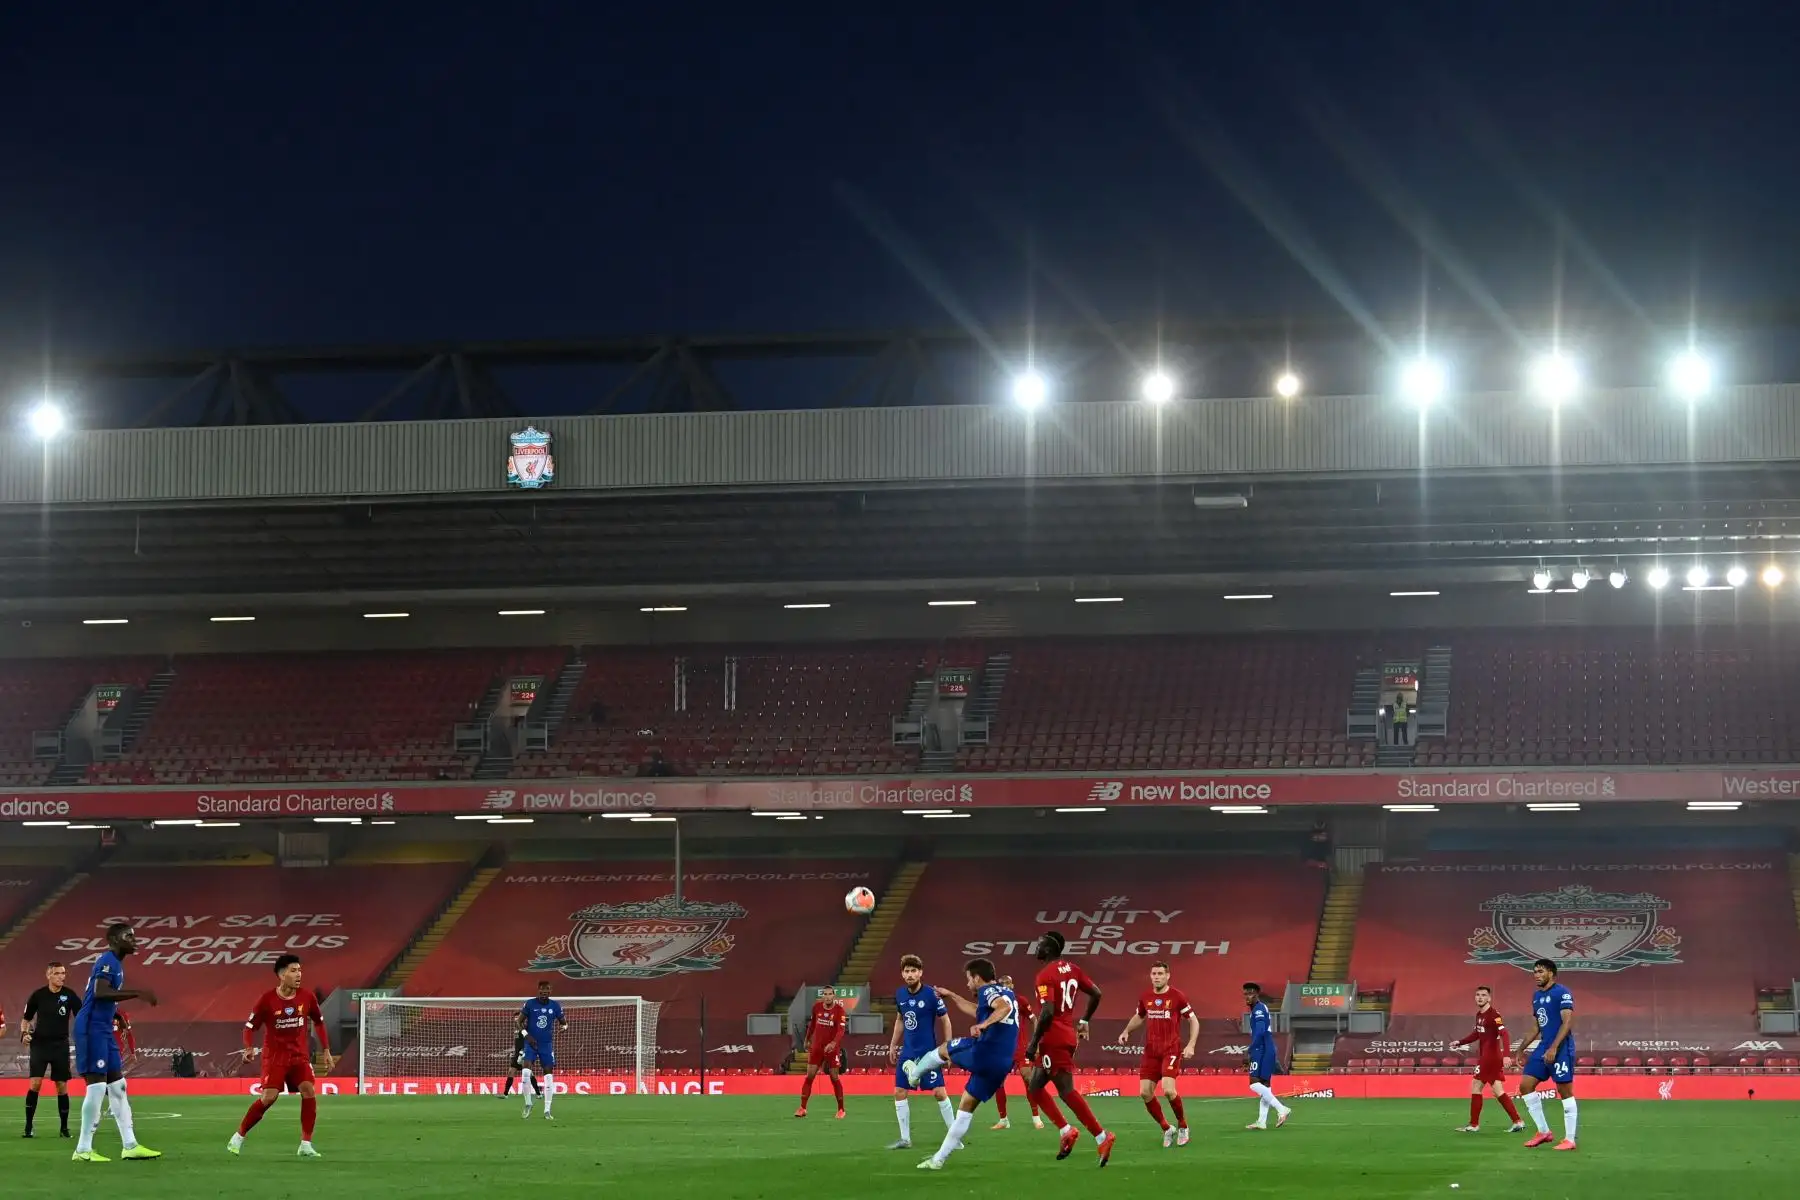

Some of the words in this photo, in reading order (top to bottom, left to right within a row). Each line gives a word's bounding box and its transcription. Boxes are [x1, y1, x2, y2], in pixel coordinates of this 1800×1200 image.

[1131, 785, 1175, 800] new
[1179, 780, 1271, 799] balance
[1398, 779, 1490, 798] Standard
[1495, 777, 1598, 797] Chartered
[1724, 776, 1800, 795] Wester
[523, 794, 565, 809] new
[569, 789, 657, 808] balance
[768, 786, 854, 805] Standard
[860, 784, 956, 804] Chartered
[0, 798, 70, 816] alance
[197, 795, 281, 813] Standard
[286, 793, 378, 811] Chartered
[97, 915, 213, 929] STAY
[219, 913, 343, 927] SAFE.
[1035, 910, 1184, 924] UNITY
[1507, 917, 1644, 925] LIVERPOOL
[585, 924, 711, 934] LIVERPOOL
[1079, 925, 1125, 939] IS
[285, 934, 349, 949] US
[143, 950, 288, 966] HOME
[817, 989, 840, 997] ET
[1060, 978, 1079, 1012] 10
[1302, 986, 1322, 995] EXIT
[366, 1002, 377, 1010] 24
[1313, 997, 1330, 1006] 126
[706, 1044, 754, 1053] AXA
[1732, 1041, 1783, 1050] AXA
[1042, 1055, 1052, 1069] 0
[1170, 1055, 1177, 1066] 7
[1554, 1061, 1568, 1074] 24
[1474, 1064, 1481, 1074] 6
[436, 1081, 592, 1095] WINNRS
[609, 1081, 725, 1095] RANGE
